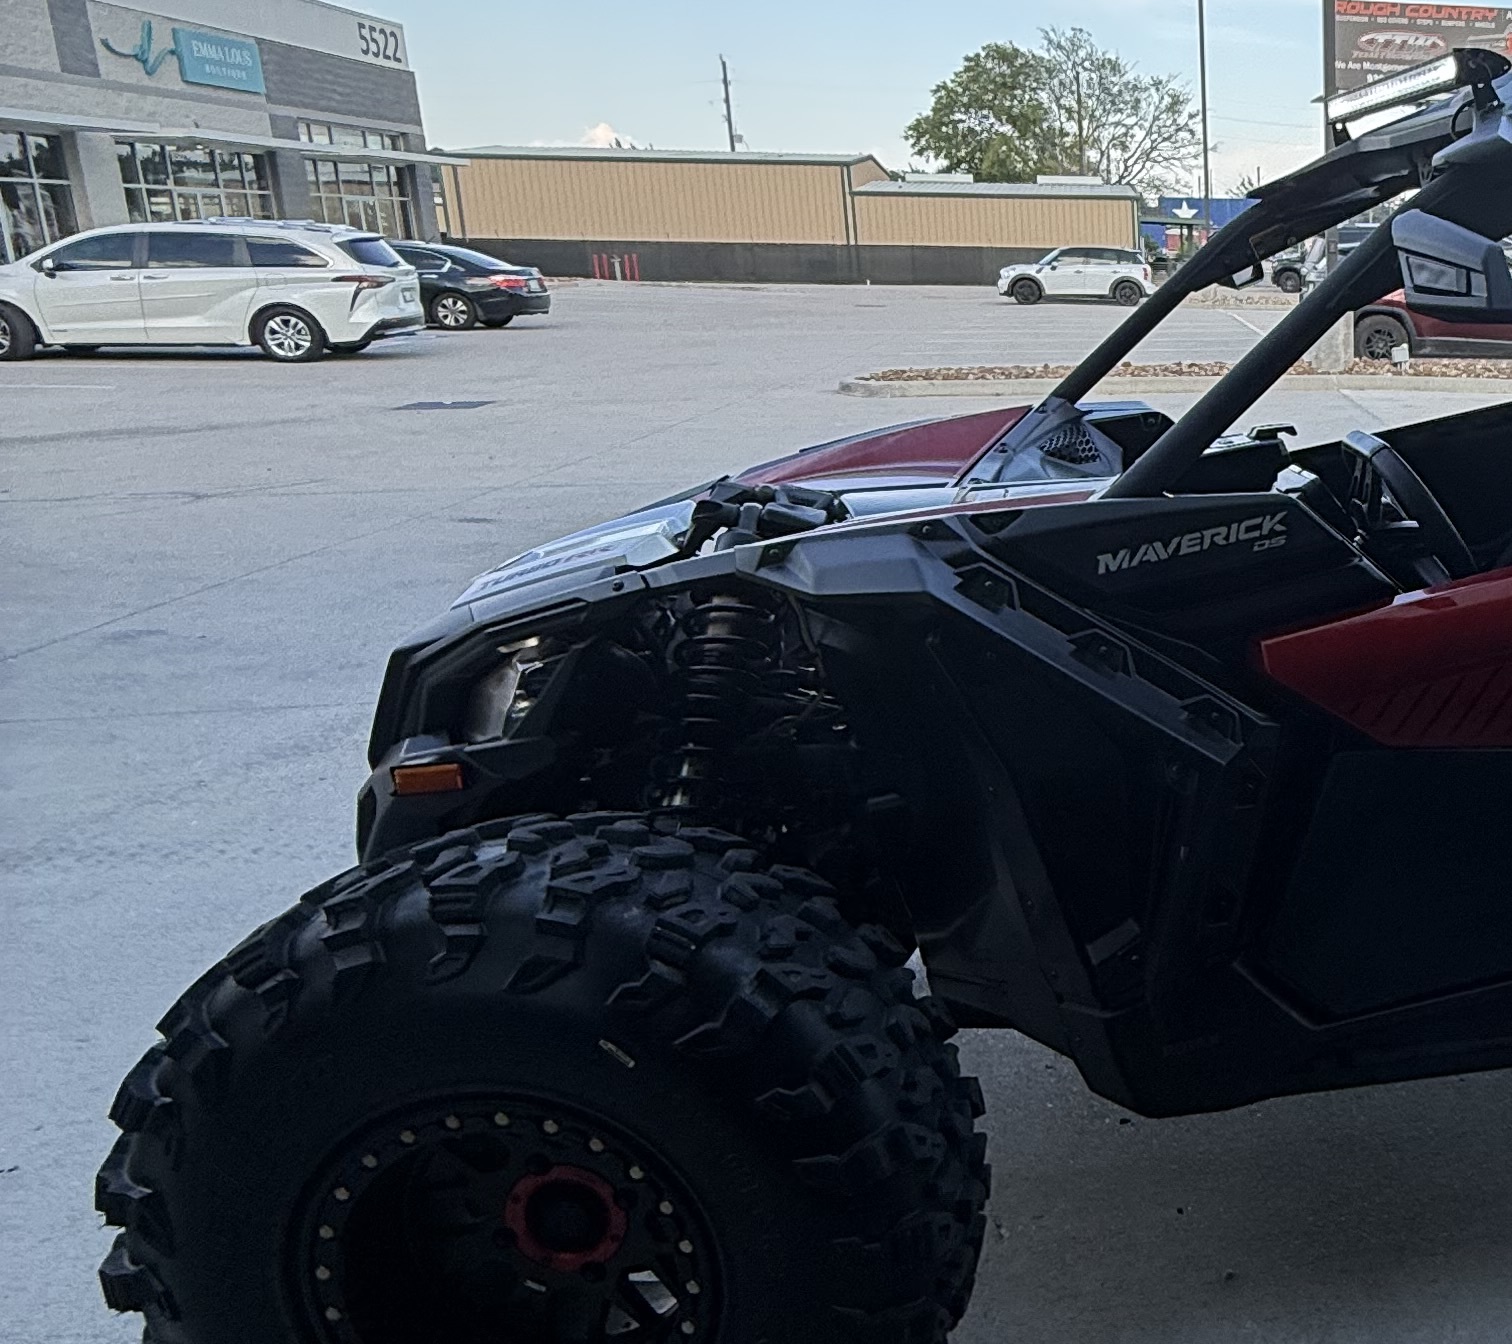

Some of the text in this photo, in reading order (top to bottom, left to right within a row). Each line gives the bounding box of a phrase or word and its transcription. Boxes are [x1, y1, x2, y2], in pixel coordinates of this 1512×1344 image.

[1336, 1, 1498, 20] ROUGH COUNTRY
[191, 40, 224, 61] EMMA
[356, 21, 403, 63] 5522
[1096, 511, 1288, 575] MAVERICK
[1252, 535, 1287, 552] DS
